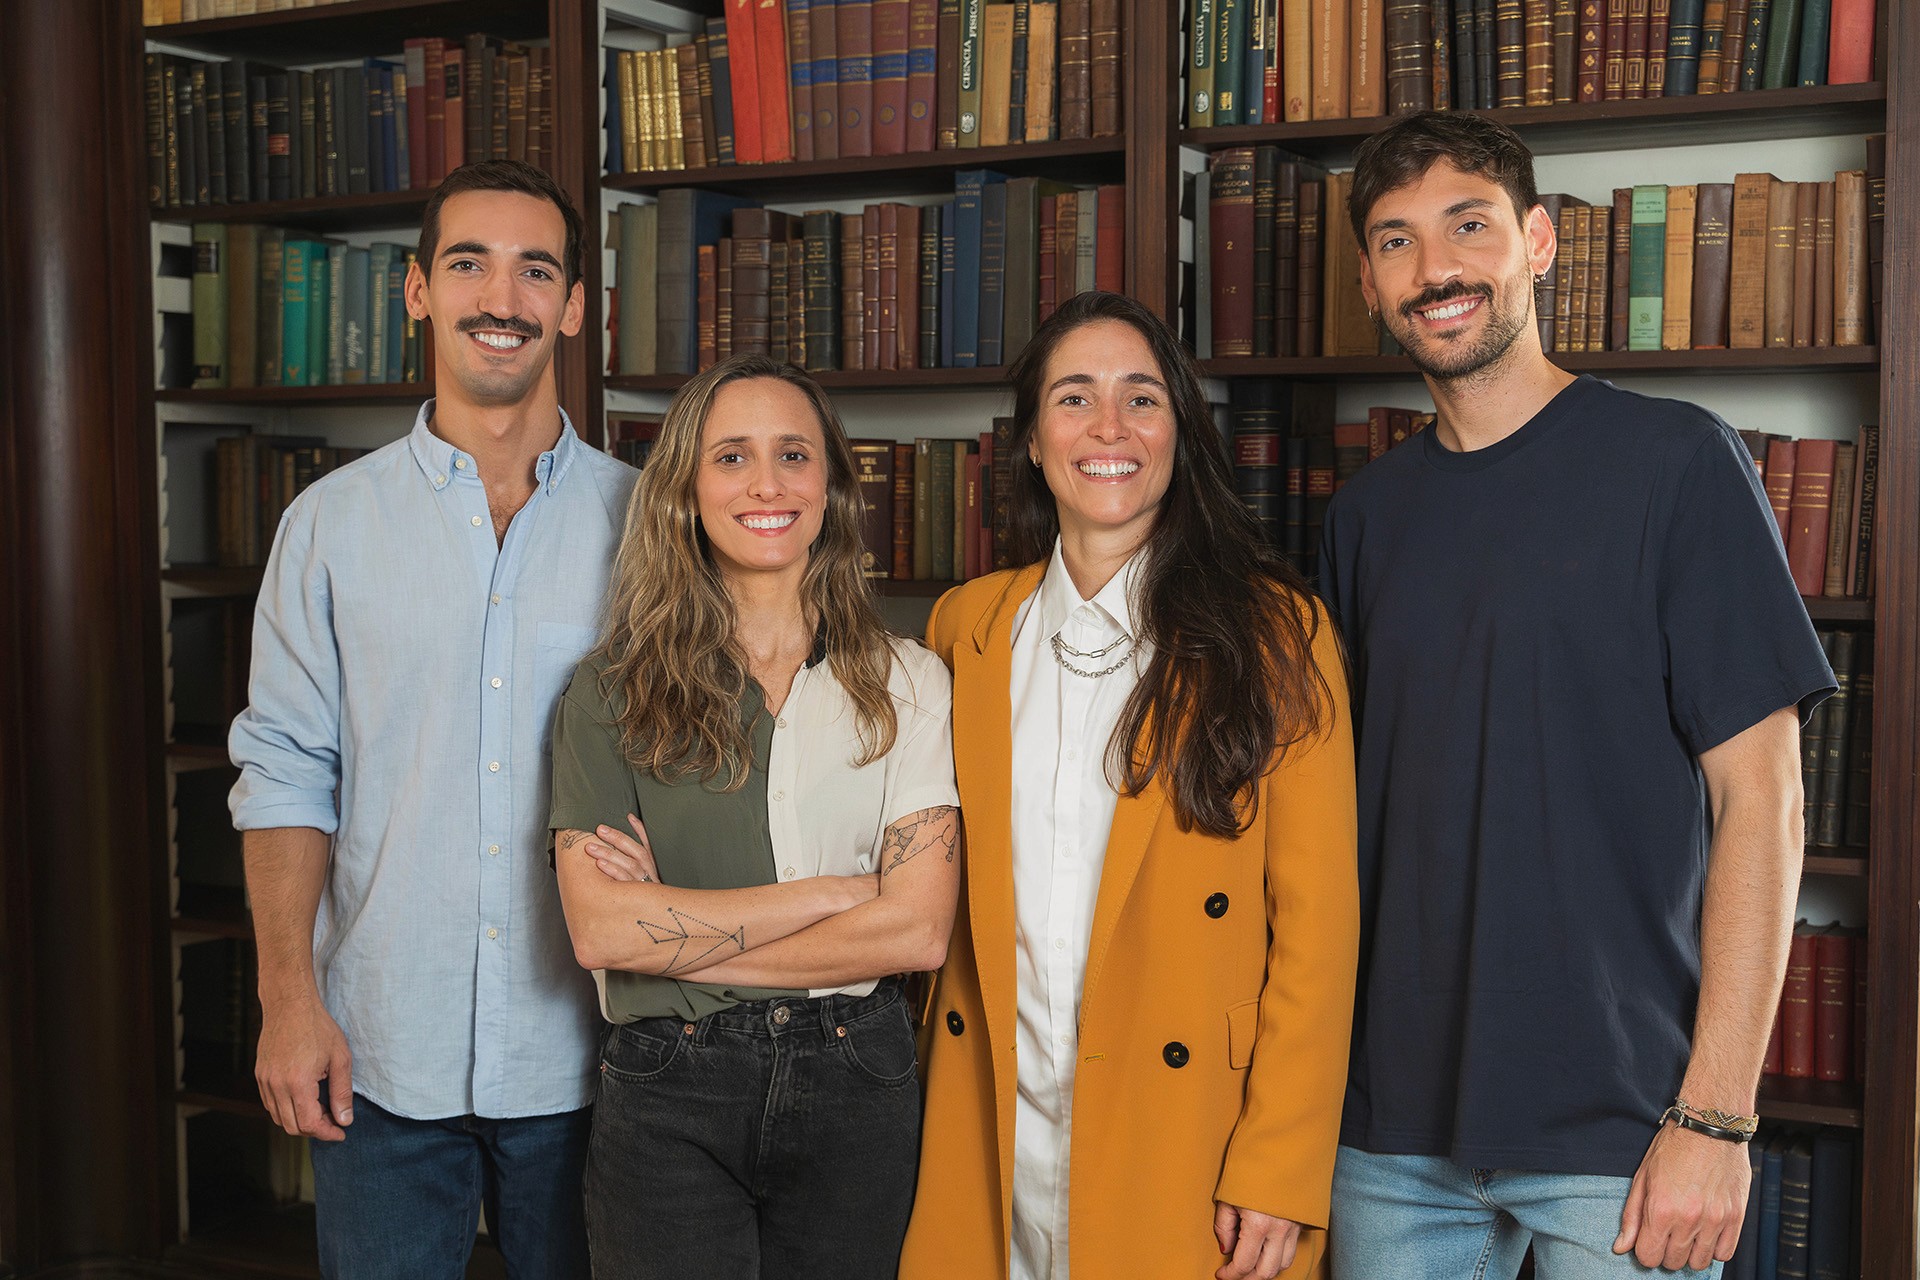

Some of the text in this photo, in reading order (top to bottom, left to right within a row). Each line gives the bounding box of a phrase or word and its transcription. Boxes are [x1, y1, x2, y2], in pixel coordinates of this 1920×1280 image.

[1194, 15, 1205, 67] CIENCIA
[1218, 11, 1230, 63] CIENCIA
[961, 39, 972, 90] CIENCIA
[1226, 241, 1234, 250] 2
[1369, 418, 1378, 450] COLINA
[1862, 427, 1879, 502] SMALL-TOWN
[1860, 504, 1873, 540] STUFF
